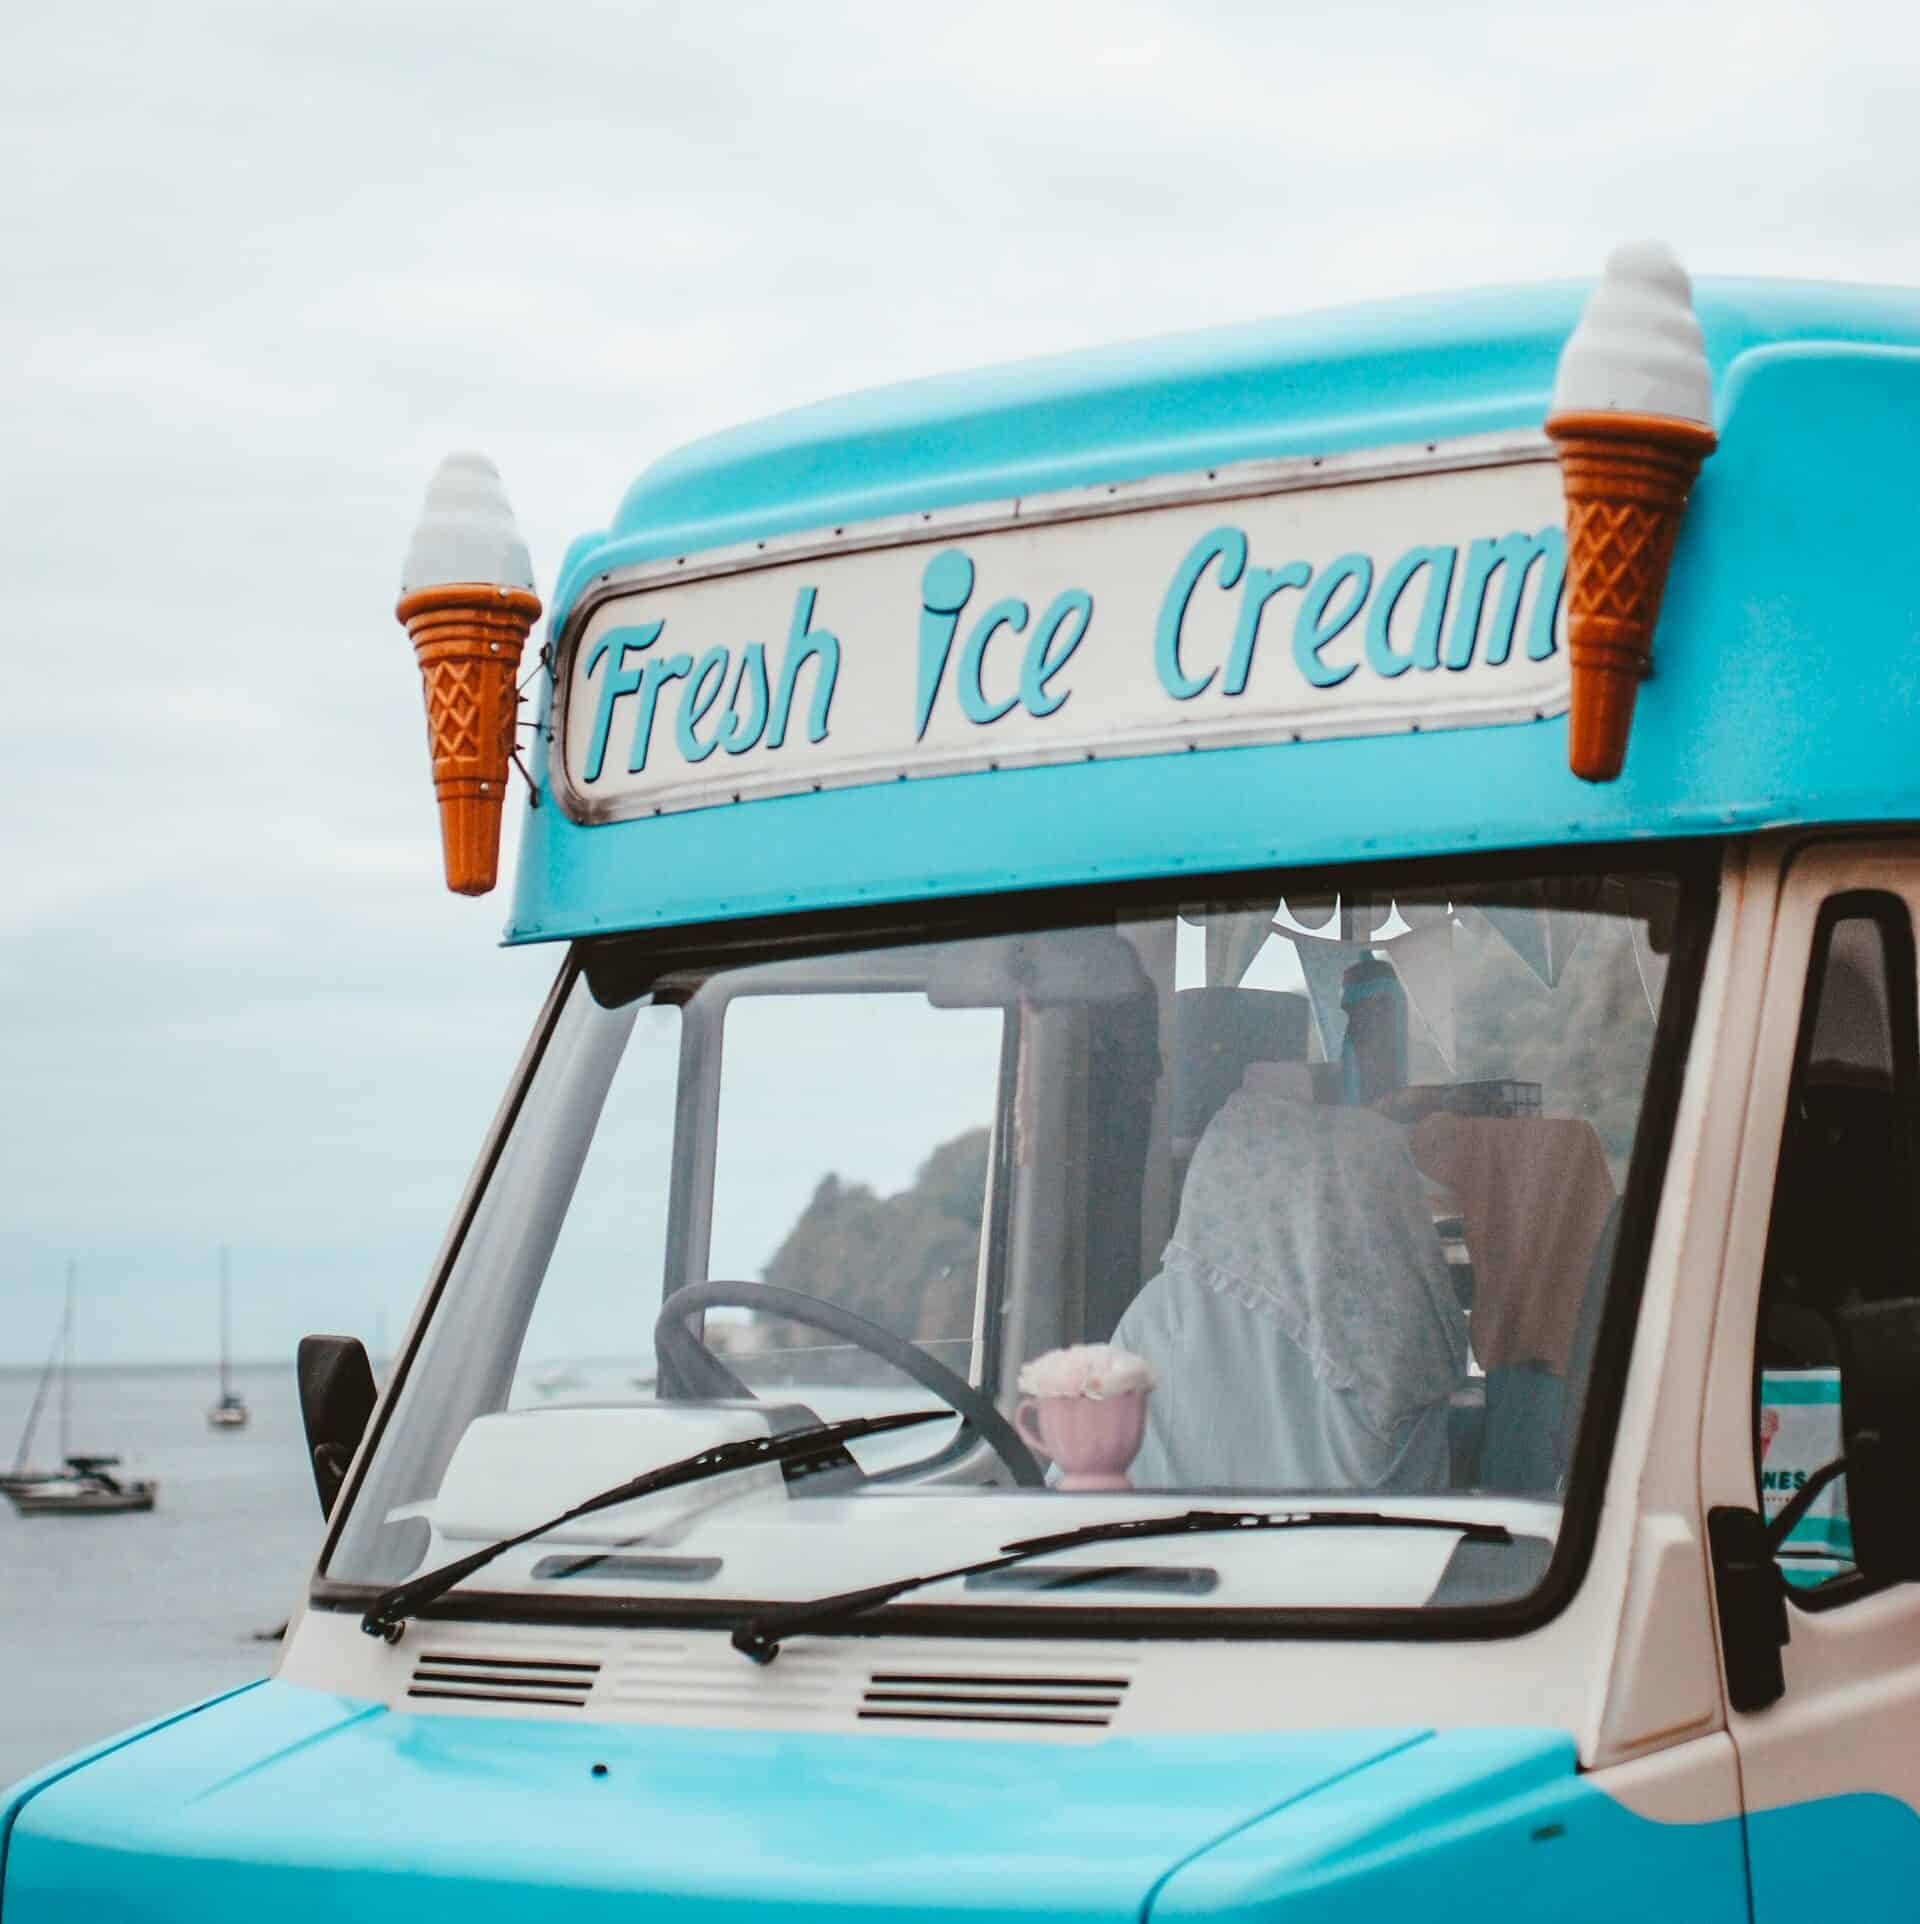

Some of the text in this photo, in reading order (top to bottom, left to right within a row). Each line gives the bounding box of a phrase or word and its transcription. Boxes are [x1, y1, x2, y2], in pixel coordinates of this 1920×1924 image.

[584, 586, 840, 784] Fresh
[1153, 525, 1568, 700] Cream
[1763, 1470, 1808, 1490] NES
